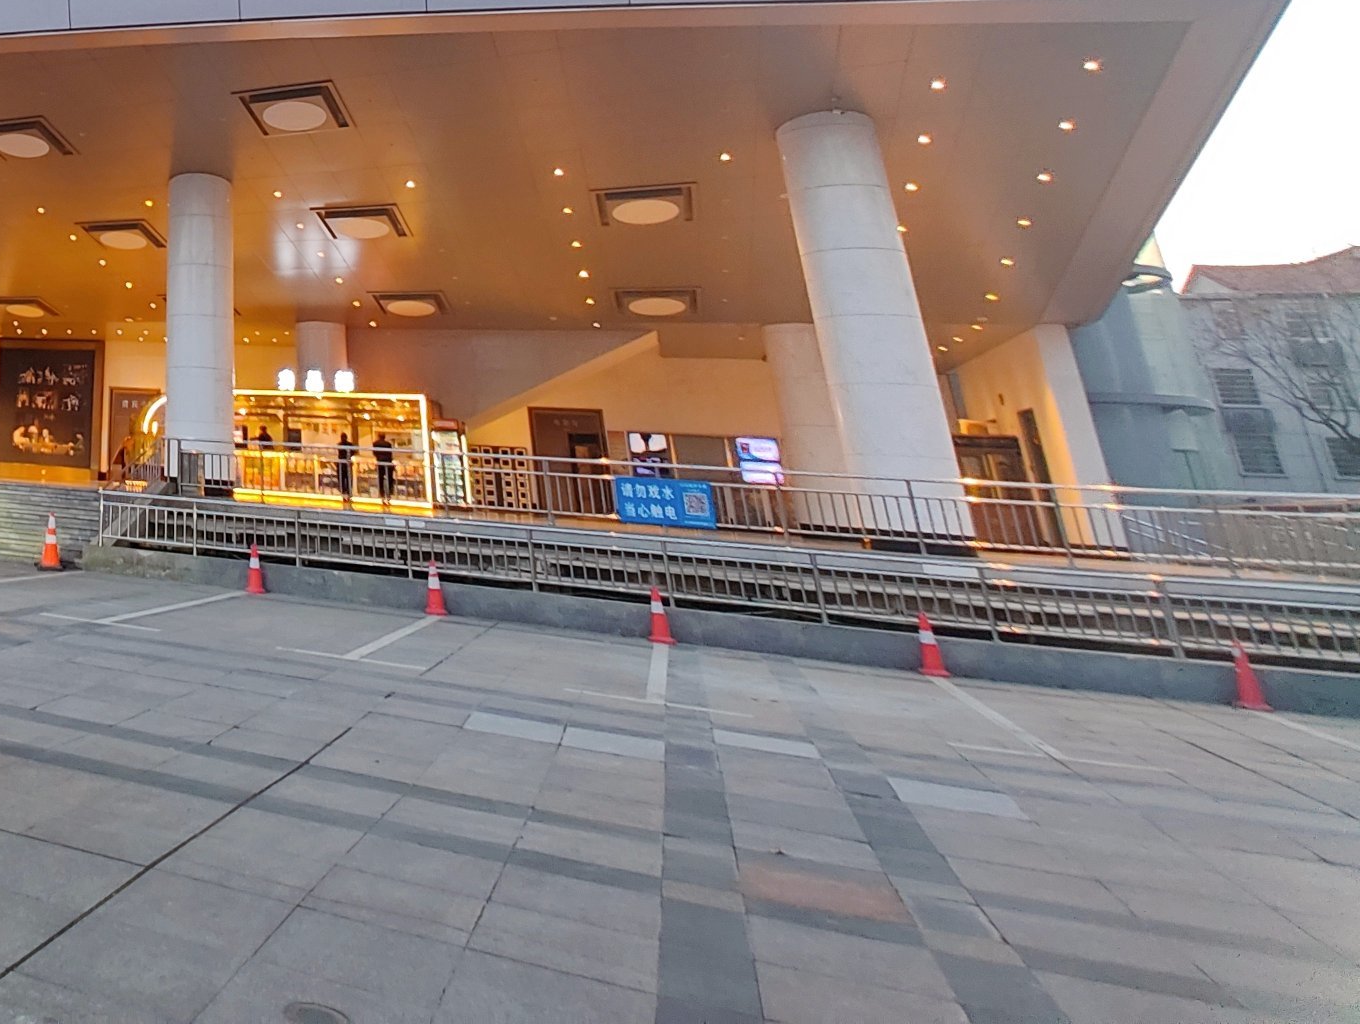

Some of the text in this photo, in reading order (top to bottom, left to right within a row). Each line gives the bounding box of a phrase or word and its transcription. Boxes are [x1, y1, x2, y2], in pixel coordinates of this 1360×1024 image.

[621, 482, 675, 501] 请勿戏水
[624, 501, 678, 520] 当心触电
